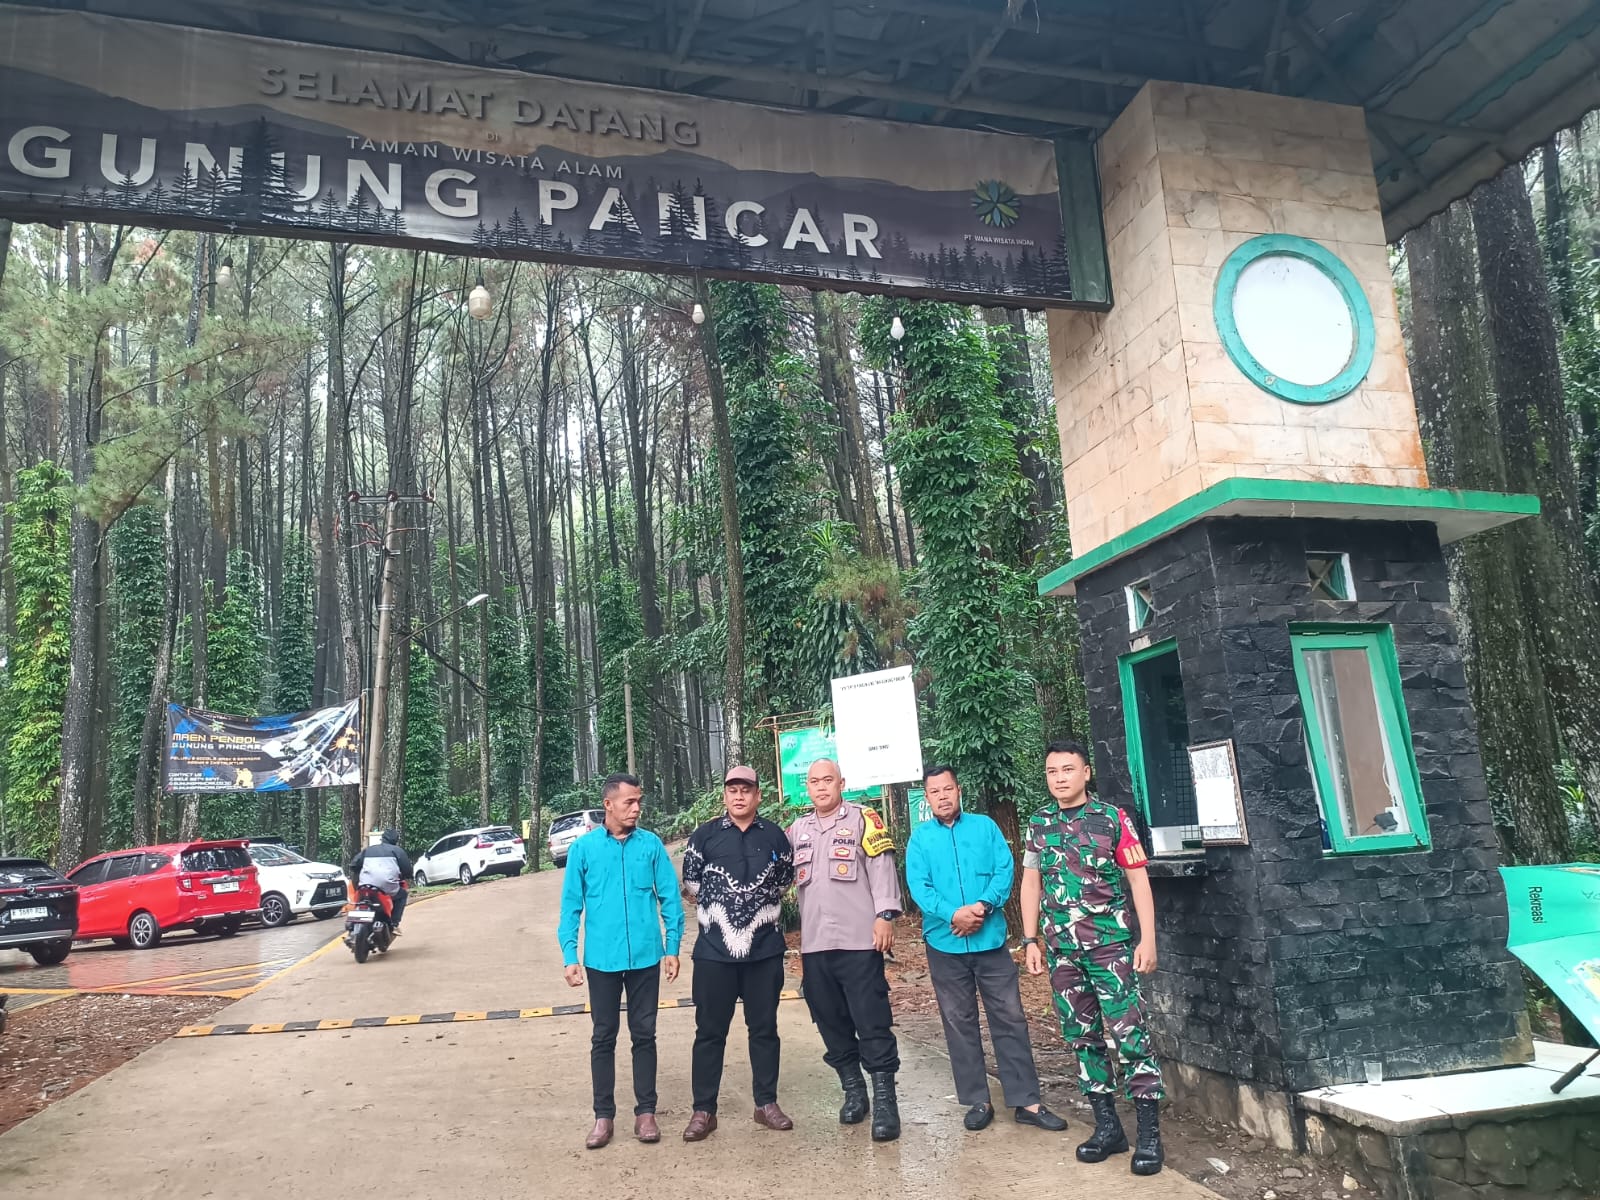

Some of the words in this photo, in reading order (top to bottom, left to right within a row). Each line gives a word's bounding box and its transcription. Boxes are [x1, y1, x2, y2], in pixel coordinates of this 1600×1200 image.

[261, 65, 494, 121] SELAMAT
[513, 99, 699, 146] DATANG
[347, 135, 438, 158] TAMAN
[452, 147, 544, 170] WISATA
[558, 160, 623, 179] ALAM
[7, 126, 479, 217] GUNUNG
[538, 179, 882, 259] PANCAR
[171, 742, 214, 750] GUNUNG
[218, 743, 262, 751] PANCAR
[832, 838, 856, 846] POLRI
[1528, 886, 1547, 924] Rekreasi
